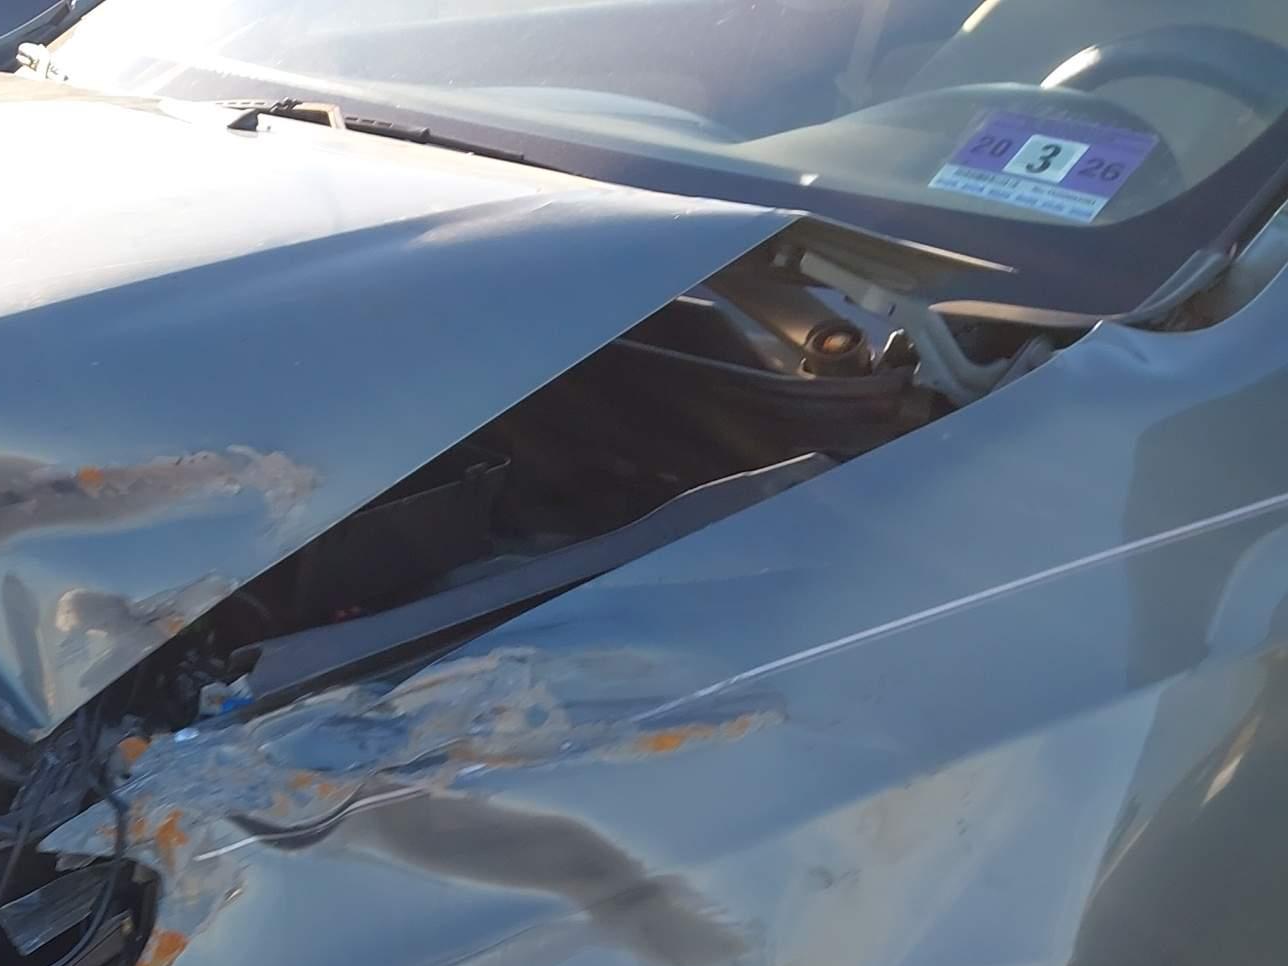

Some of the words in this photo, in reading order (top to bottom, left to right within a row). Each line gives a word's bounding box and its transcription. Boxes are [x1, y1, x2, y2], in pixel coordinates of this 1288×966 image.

[970, 135, 1013, 159] 20
[1025, 143, 1063, 174] 3
[1078, 157, 1125, 182] 26
